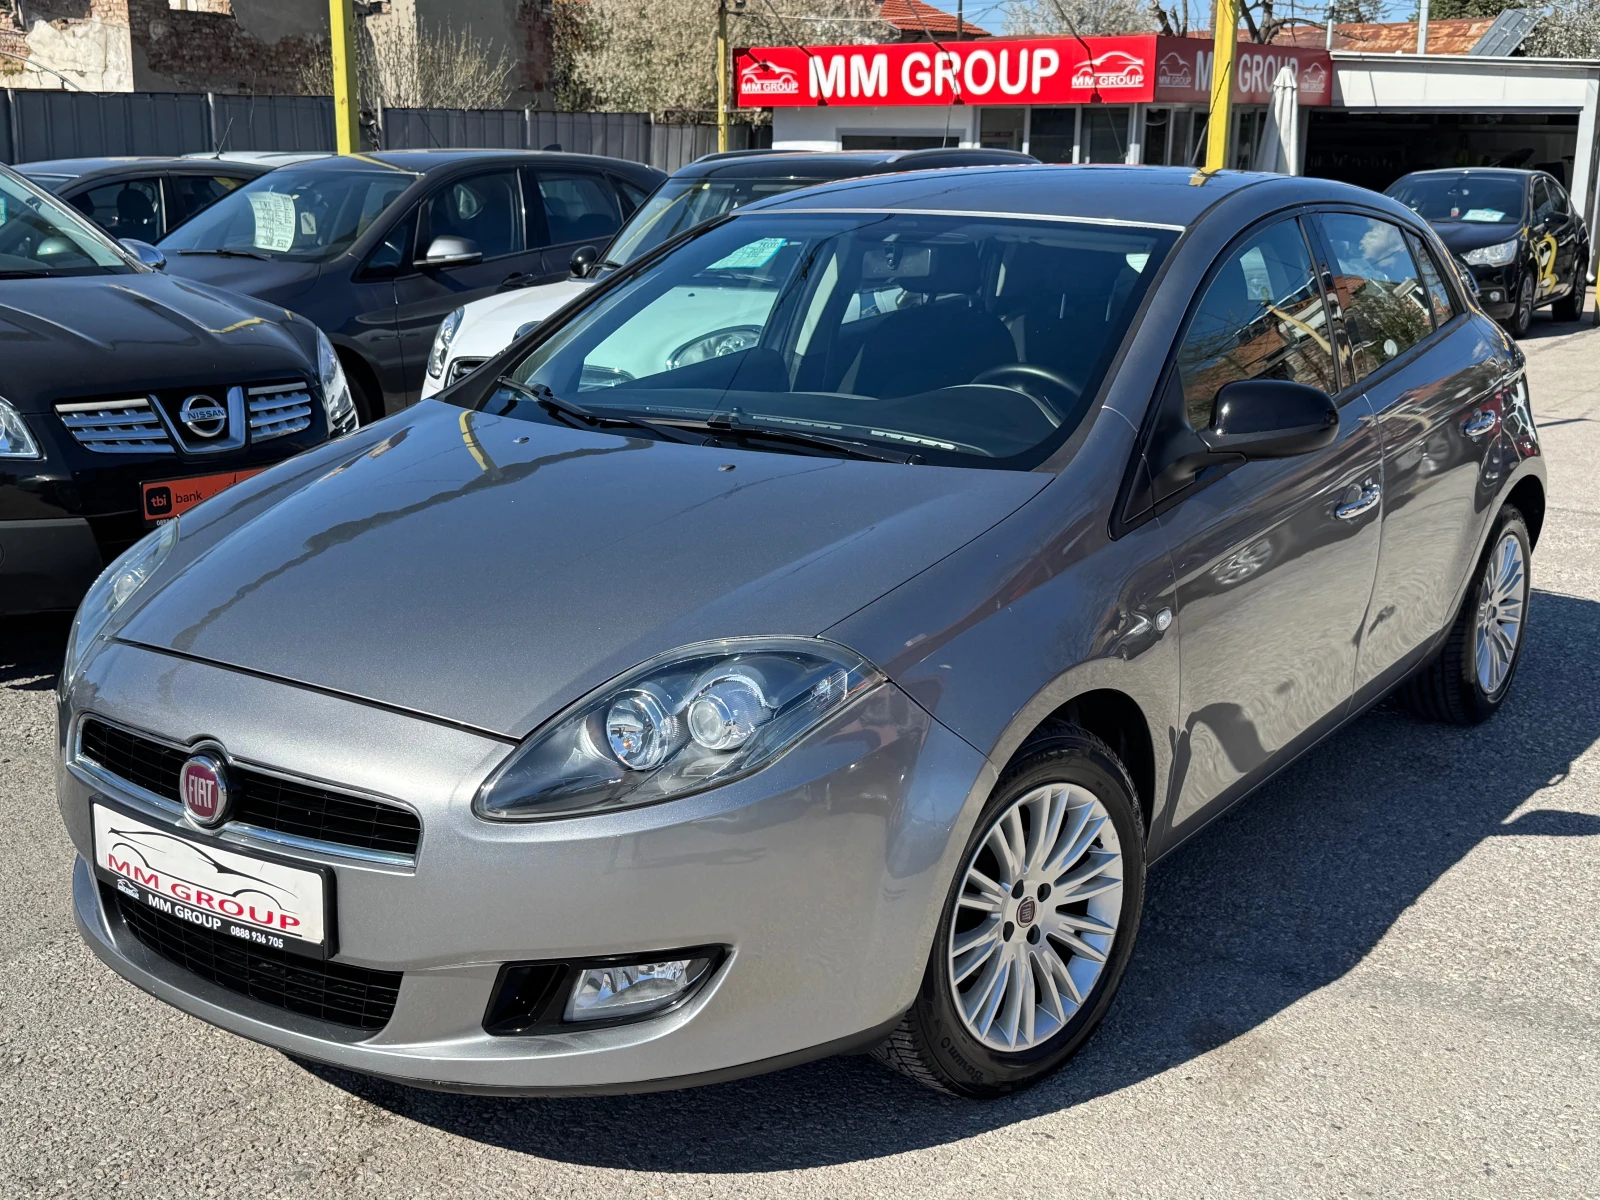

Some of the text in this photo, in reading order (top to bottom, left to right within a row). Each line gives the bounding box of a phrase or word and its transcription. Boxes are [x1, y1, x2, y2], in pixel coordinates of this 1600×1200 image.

[809, 47, 1060, 98] MM GROUP
[1072, 74, 1144, 86] MM GROUP
[1158, 76, 1192, 85] MM GROUP
[1195, 50, 1213, 92] M
[741, 82, 799, 92] MM GROUP
[187, 409, 225, 419] NISSAN
[151, 490, 203, 507] tbi bank
[189, 774, 215, 809] FIAT
[108, 853, 301, 930] MM GROUP
[148, 893, 284, 949] MM GROUP 0888 936 705
